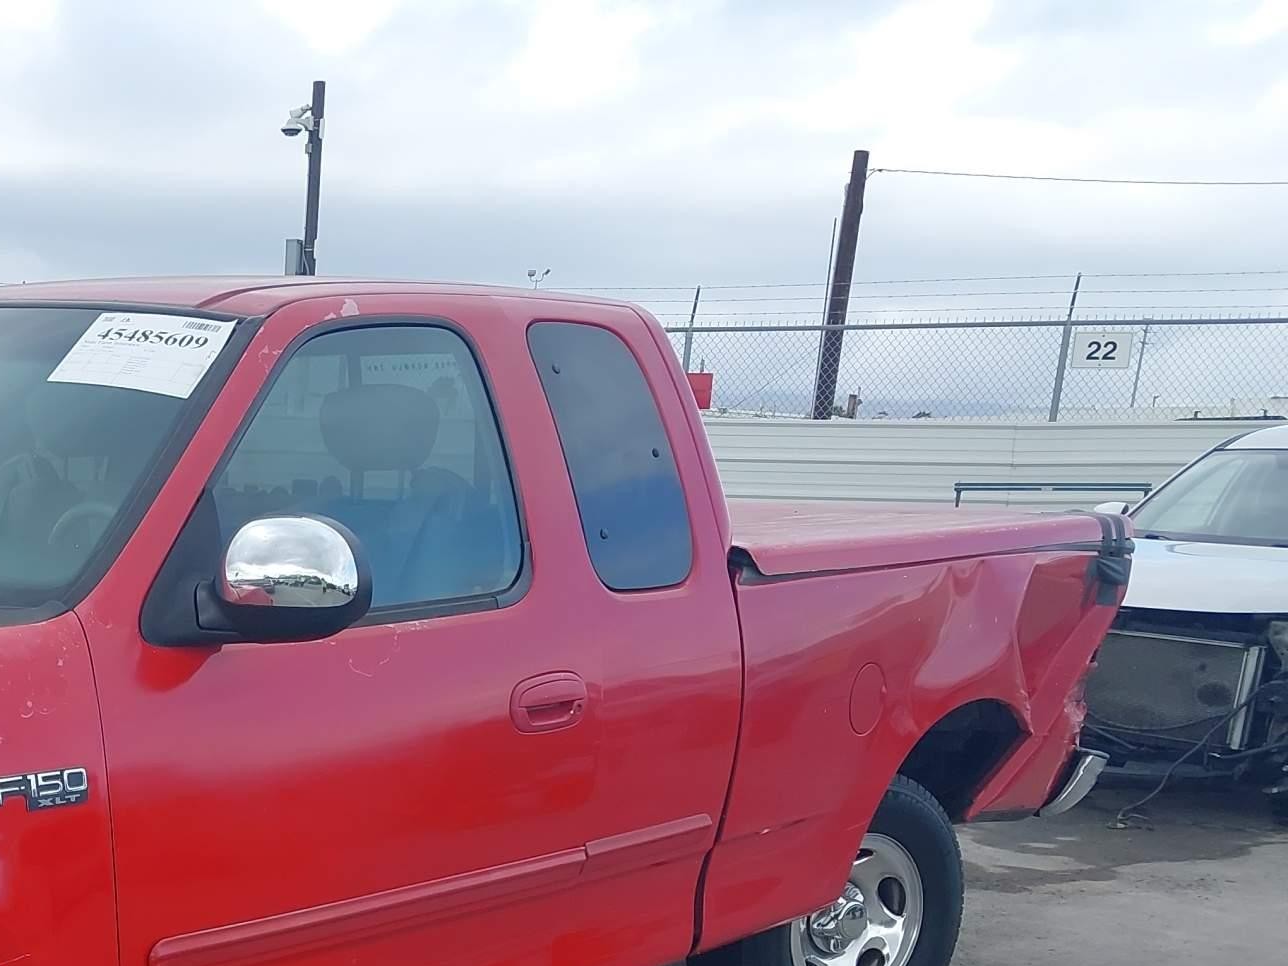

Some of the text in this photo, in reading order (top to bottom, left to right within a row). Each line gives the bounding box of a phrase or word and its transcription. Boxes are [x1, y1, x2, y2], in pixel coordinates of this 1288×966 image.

[97, 327, 209, 350] 45485609
[1086, 341, 1117, 360] 22
[38, 794, 81, 807] XLT
